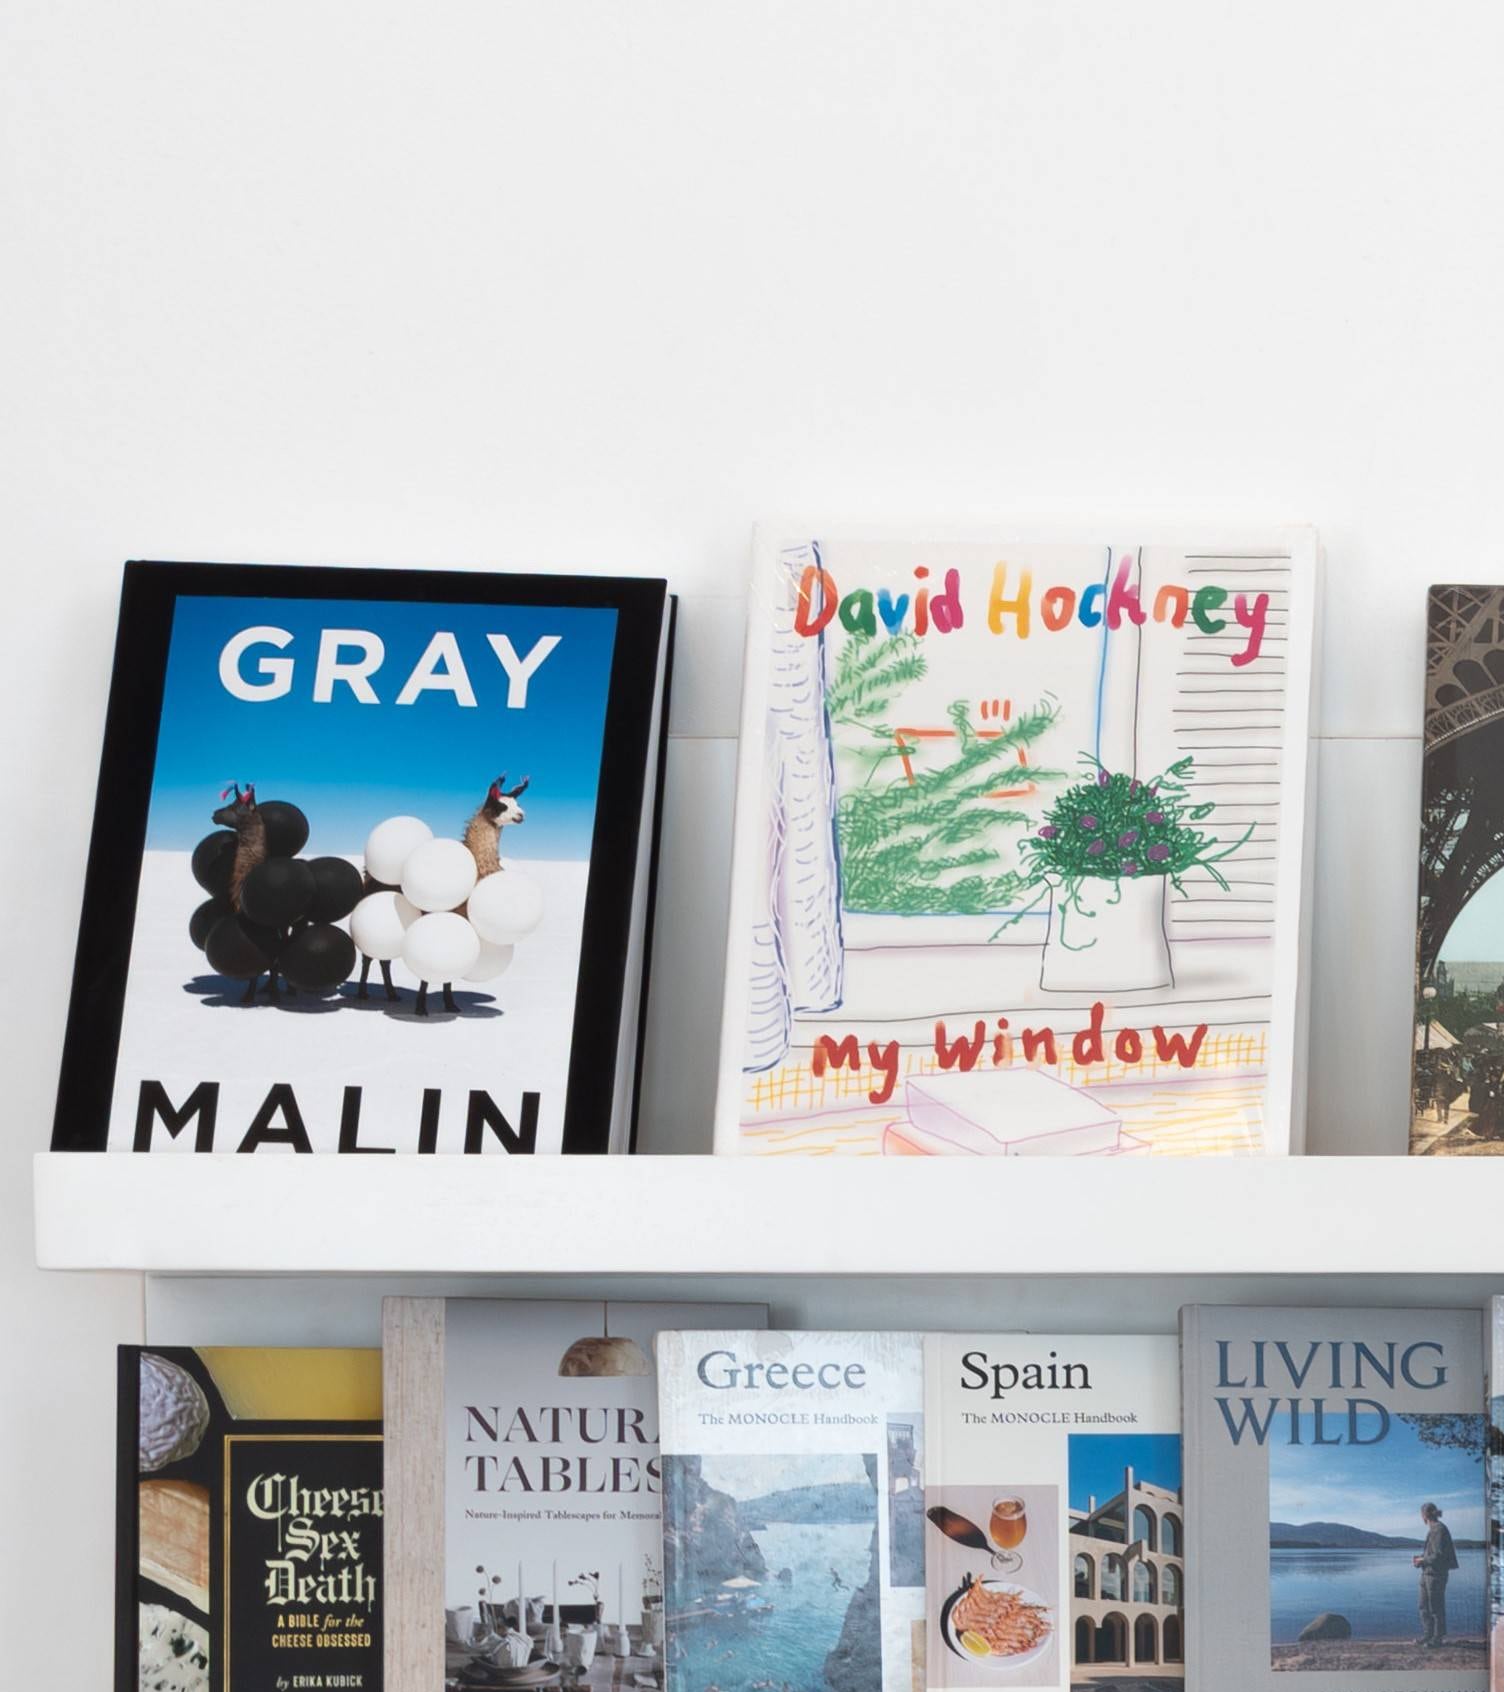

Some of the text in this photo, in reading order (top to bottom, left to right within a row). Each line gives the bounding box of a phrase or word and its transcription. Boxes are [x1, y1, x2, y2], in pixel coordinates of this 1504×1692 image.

[794, 553, 1269, 666] David Hockney
[218, 625, 561, 709] GRAY
[933, 1002, 1208, 1073] Window
[133, 1080, 540, 1153] MALIN
[697, 1350, 867, 1390] Greece
[960, 1350, 1093, 1400] Spain
[1215, 1339, 1449, 1390] LIVING
[464, 1406, 660, 1444] NATUR
[698, 1412, 879, 1425] The MONOCLE Handbook
[961, 1411, 1138, 1425] The MONOCLE Handbook
[1213, 1397, 1391, 1446] WILD
[246, 1471, 385, 1522] Cheese
[546, 1509, 616, 1522] Tablescapes for
[284, 1516, 361, 1562] Sex
[264, 1559, 377, 1612] Death
[271, 1633, 371, 1648] CHEESE OBSESSED
[277, 1613, 365, 1632] A BIBLE for the
[276, 1674, 363, 1692] by ERIKA KUBICK
